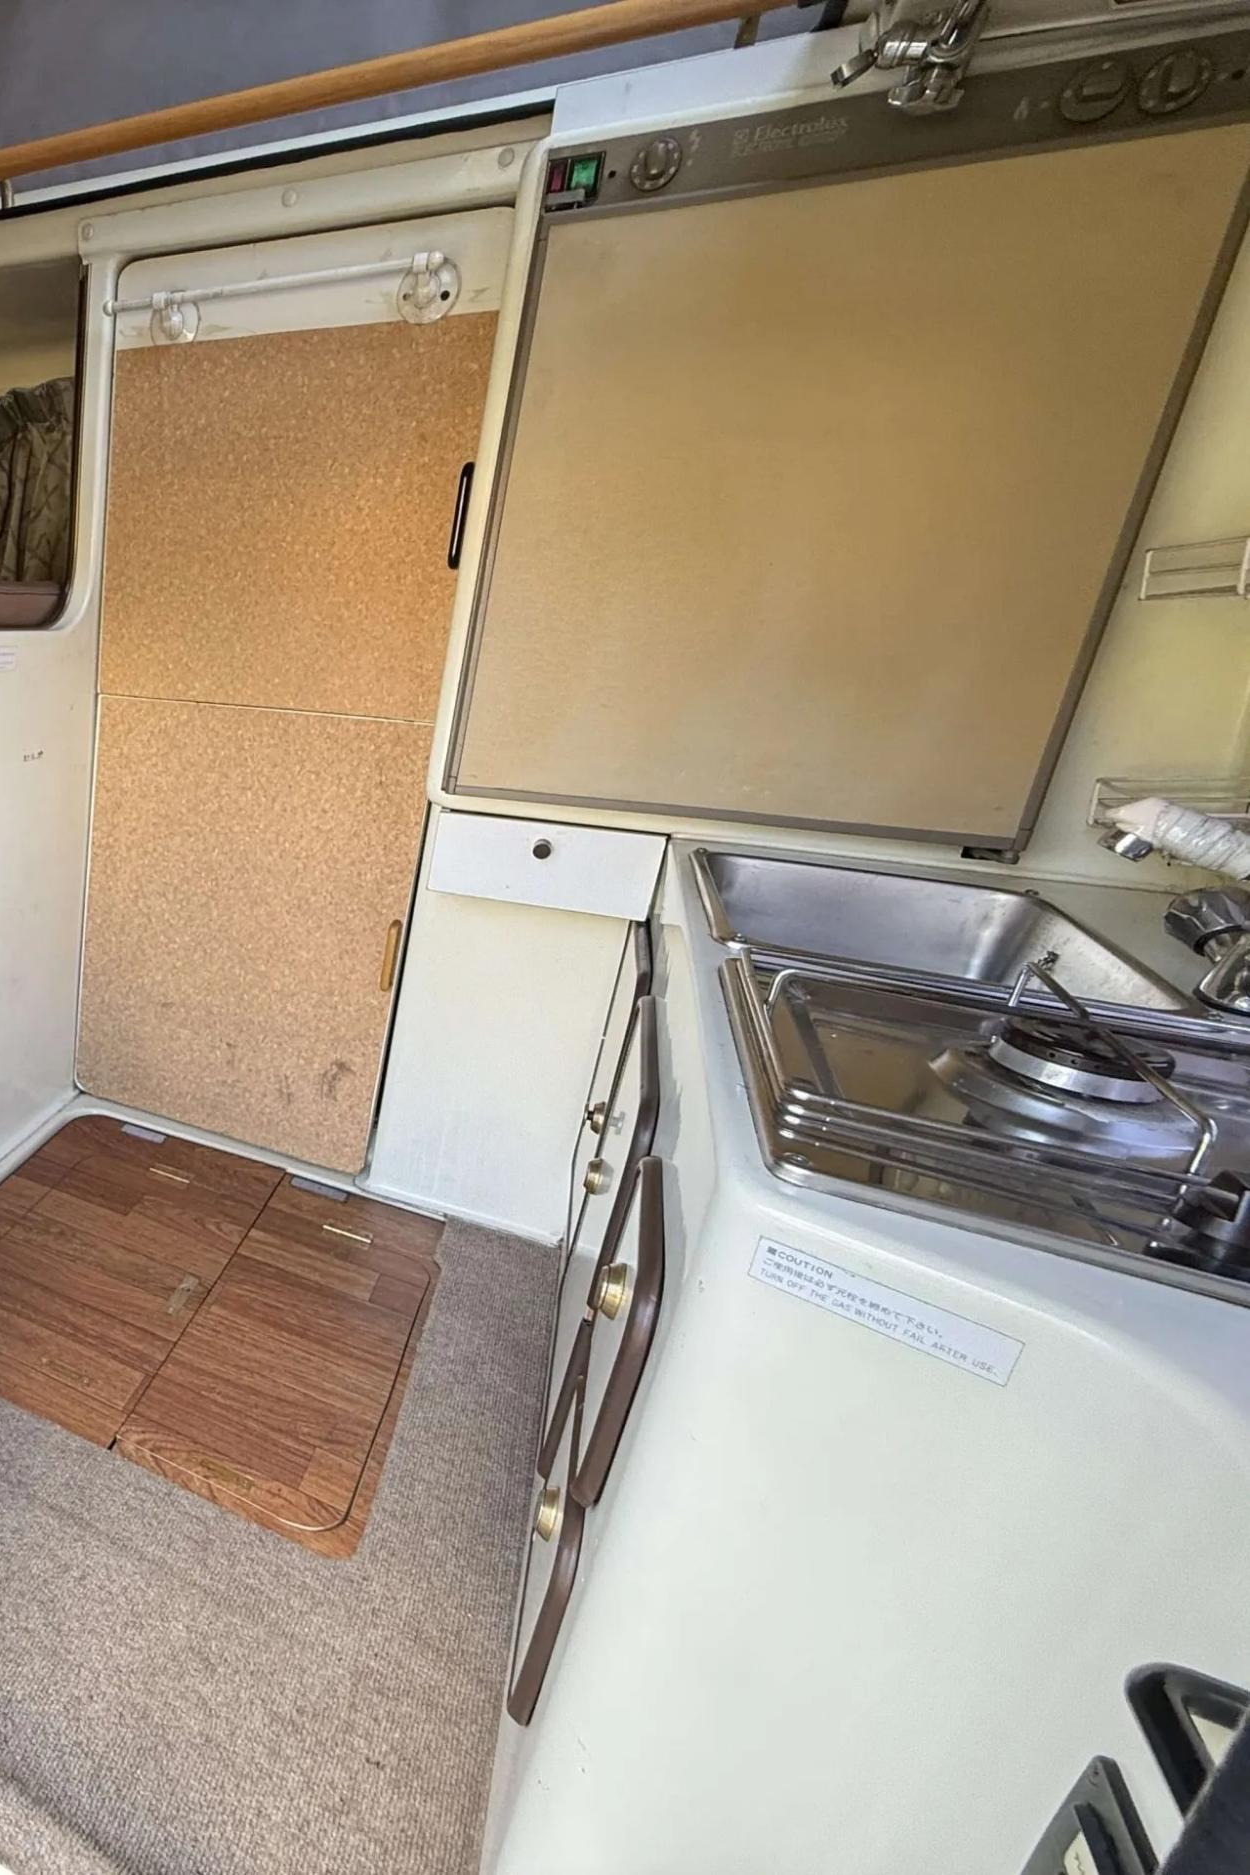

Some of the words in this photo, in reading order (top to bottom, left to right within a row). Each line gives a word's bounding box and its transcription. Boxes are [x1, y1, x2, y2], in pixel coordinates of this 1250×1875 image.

[760, 1267, 784, 1284] TURN
[786, 1279, 805, 1292] OFF
[810, 1289, 829, 1303] THE
[831, 1299, 851, 1313] GAS
[854, 1307, 899, 1333] WITHOUT
[902, 1328, 927, 1345] FAIL
